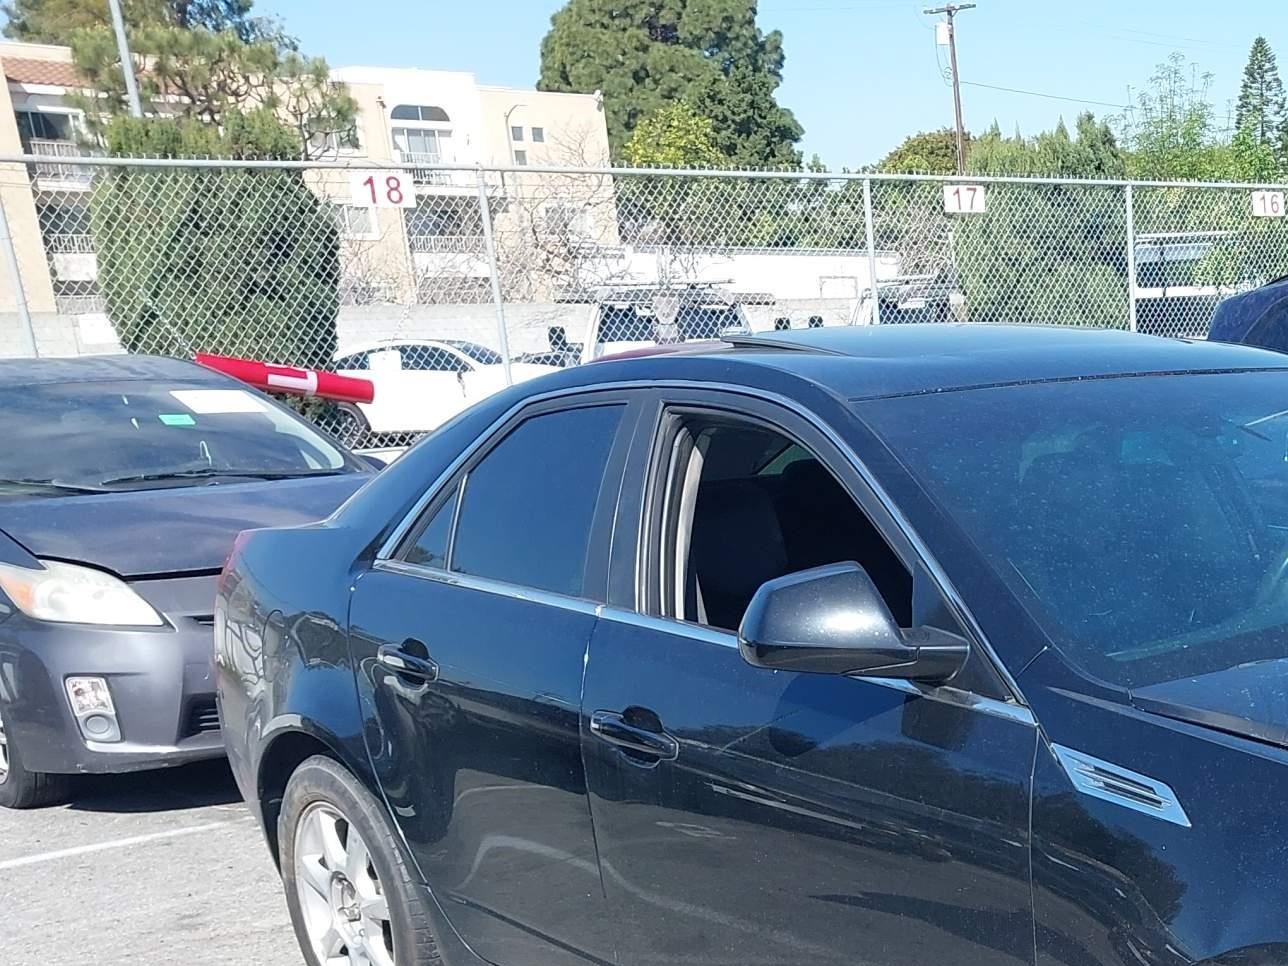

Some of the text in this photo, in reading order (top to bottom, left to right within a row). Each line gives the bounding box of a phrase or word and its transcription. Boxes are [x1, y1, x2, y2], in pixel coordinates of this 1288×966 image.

[363, 176, 403, 204] 18
[953, 187, 977, 211] 17
[1260, 193, 1280, 214] 16
